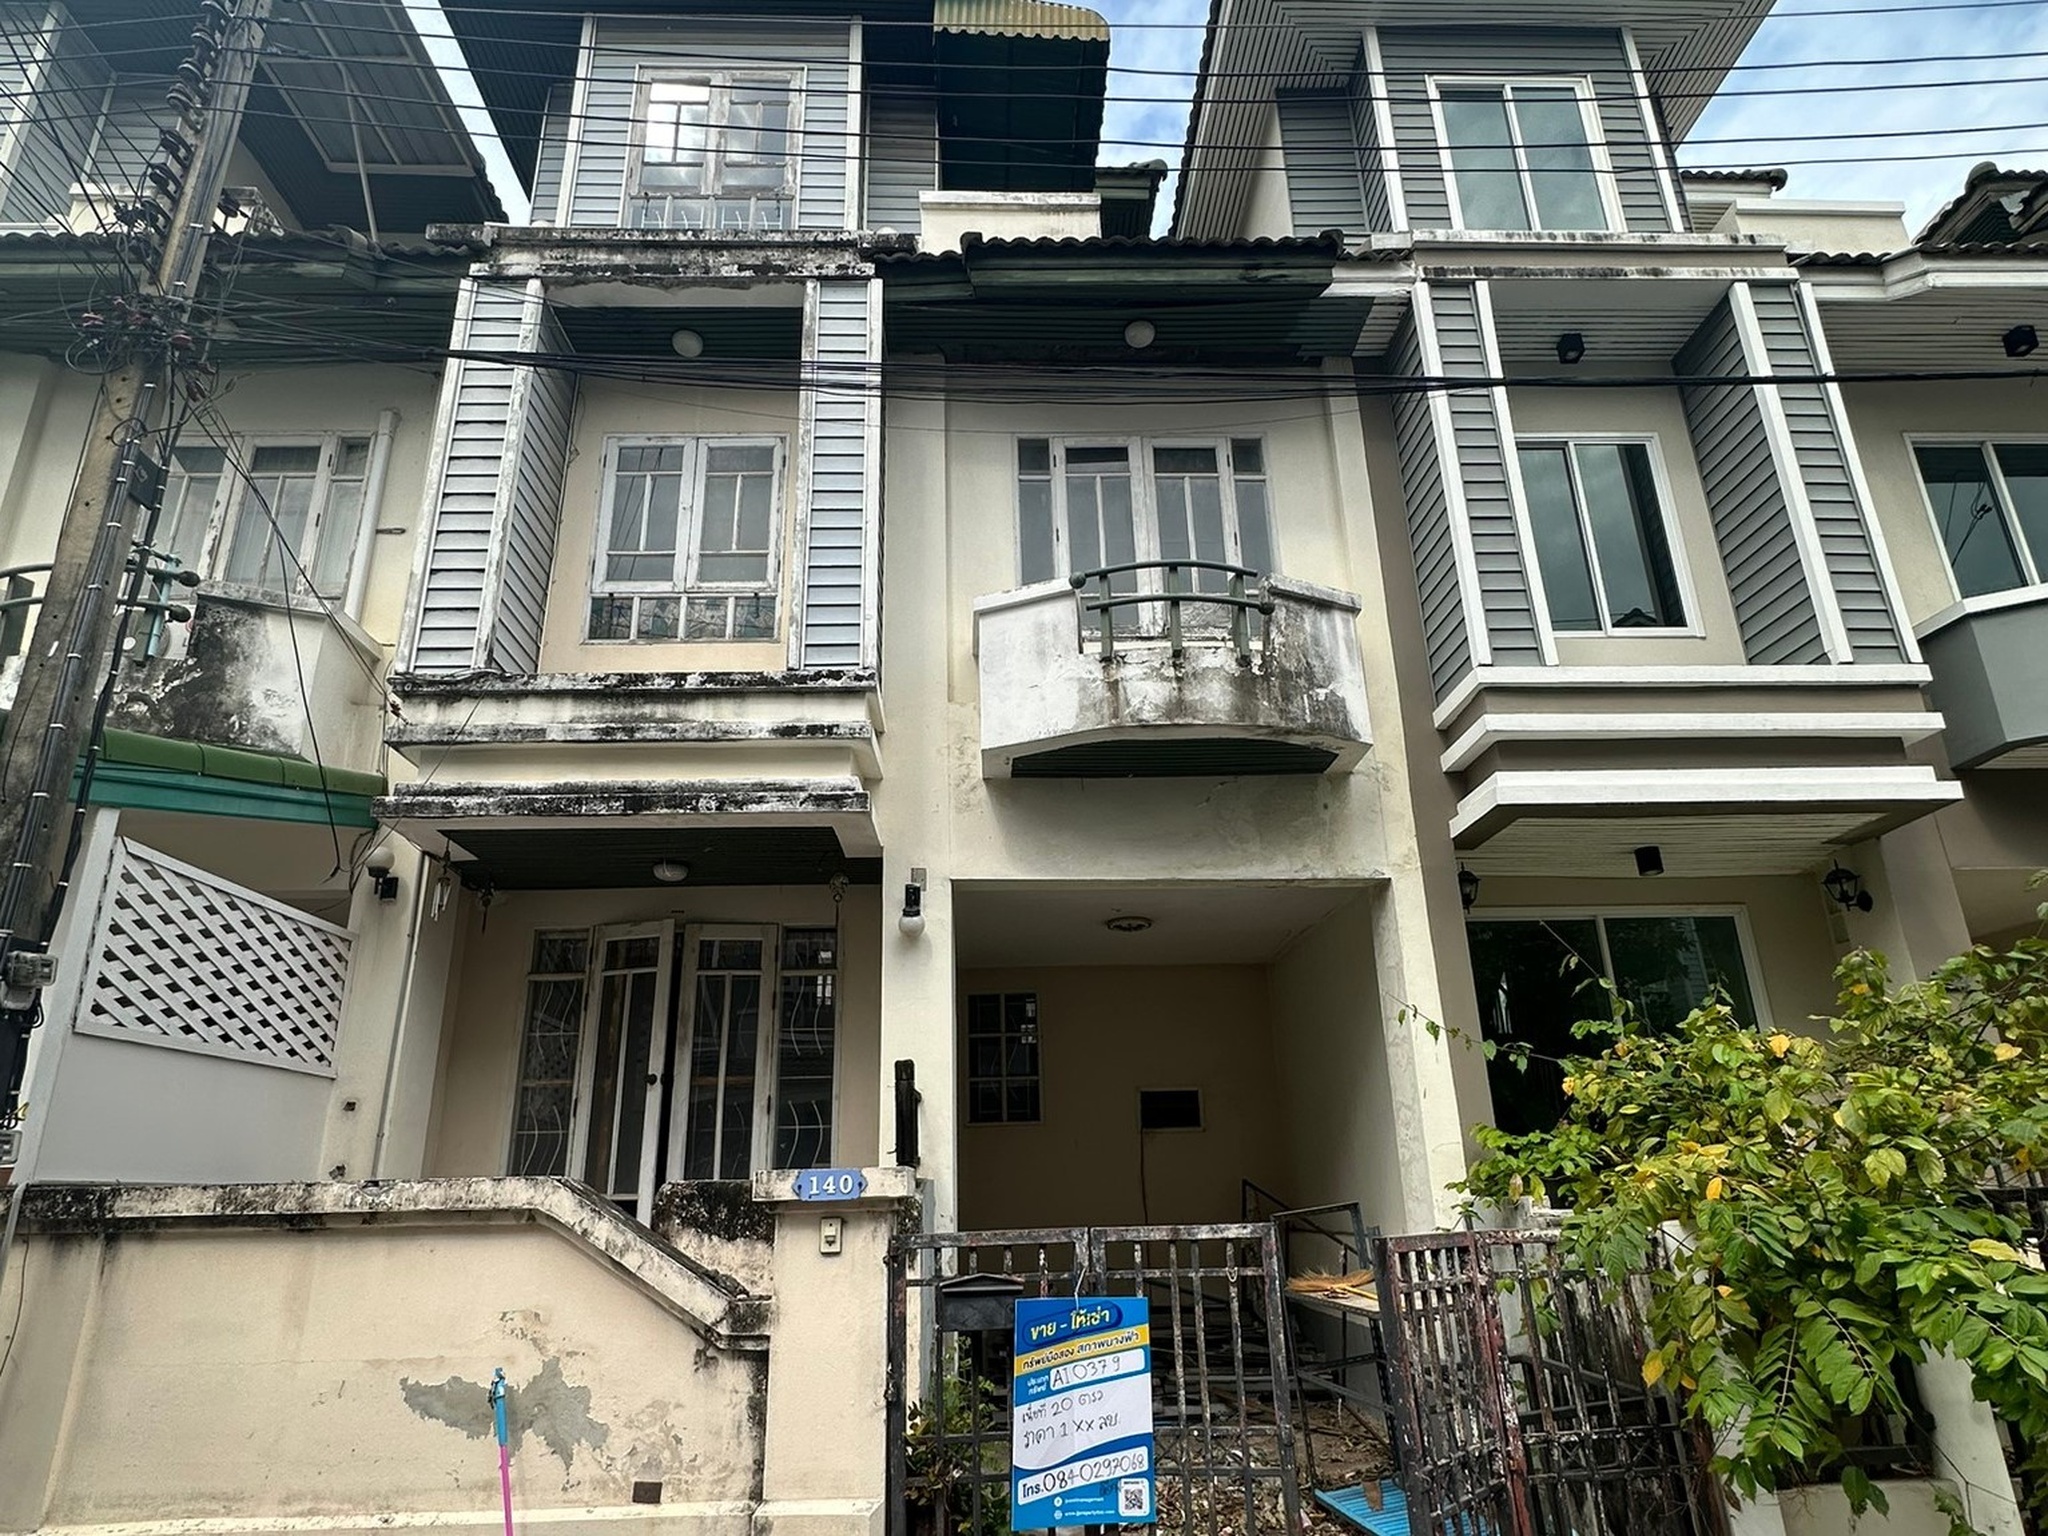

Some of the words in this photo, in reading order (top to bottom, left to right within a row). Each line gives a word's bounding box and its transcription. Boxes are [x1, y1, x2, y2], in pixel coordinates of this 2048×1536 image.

[809, 1174, 853, 1195] 140
[1030, 1321, 1057, 1341] ขาย
[1070, 1305, 1110, 1330] ให้เช่า
[1050, 1397, 1074, 1417] 20
[1023, 1425, 1055, 1449] ราคา
[1022, 1483, 1044, 1499] โทร.
